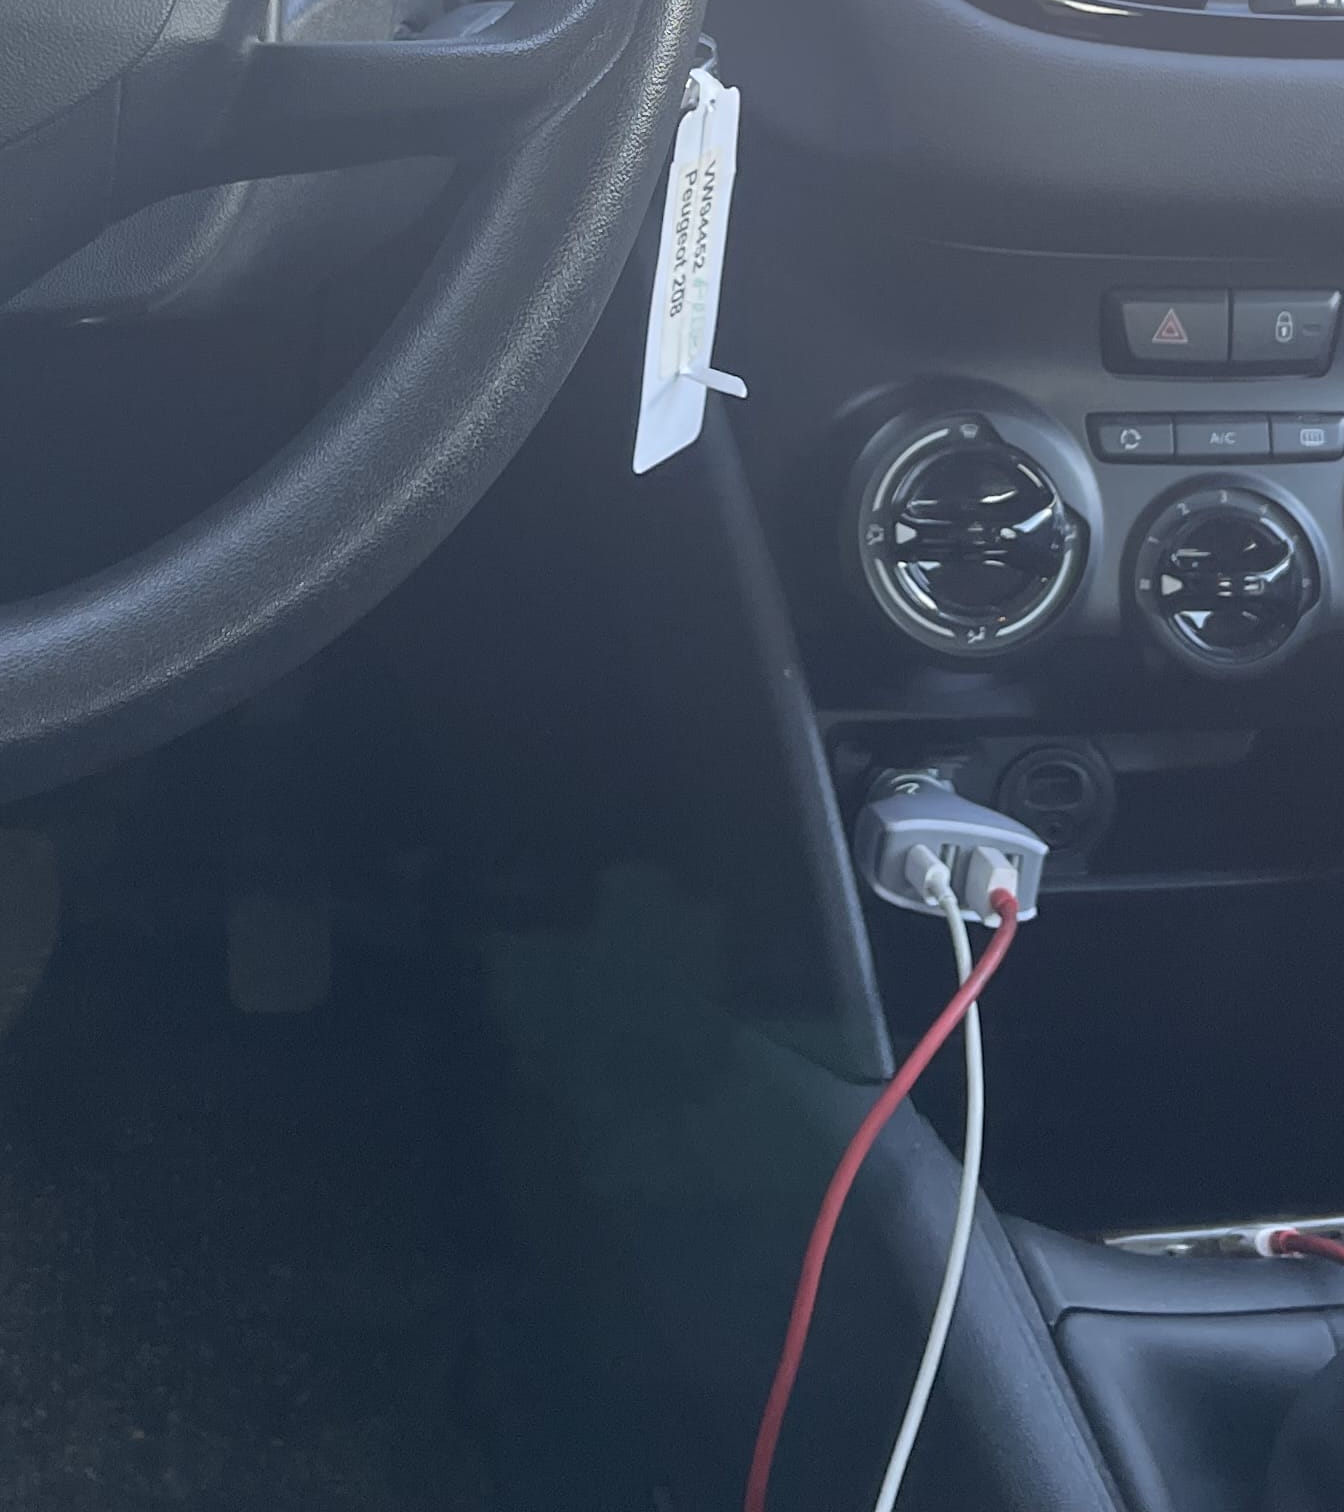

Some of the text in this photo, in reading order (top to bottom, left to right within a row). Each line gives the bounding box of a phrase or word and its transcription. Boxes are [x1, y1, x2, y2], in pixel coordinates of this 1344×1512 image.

[673, 168, 699, 271] Peugeot
[668, 273, 688, 319] 208
[1209, 430, 1238, 446] A/C
